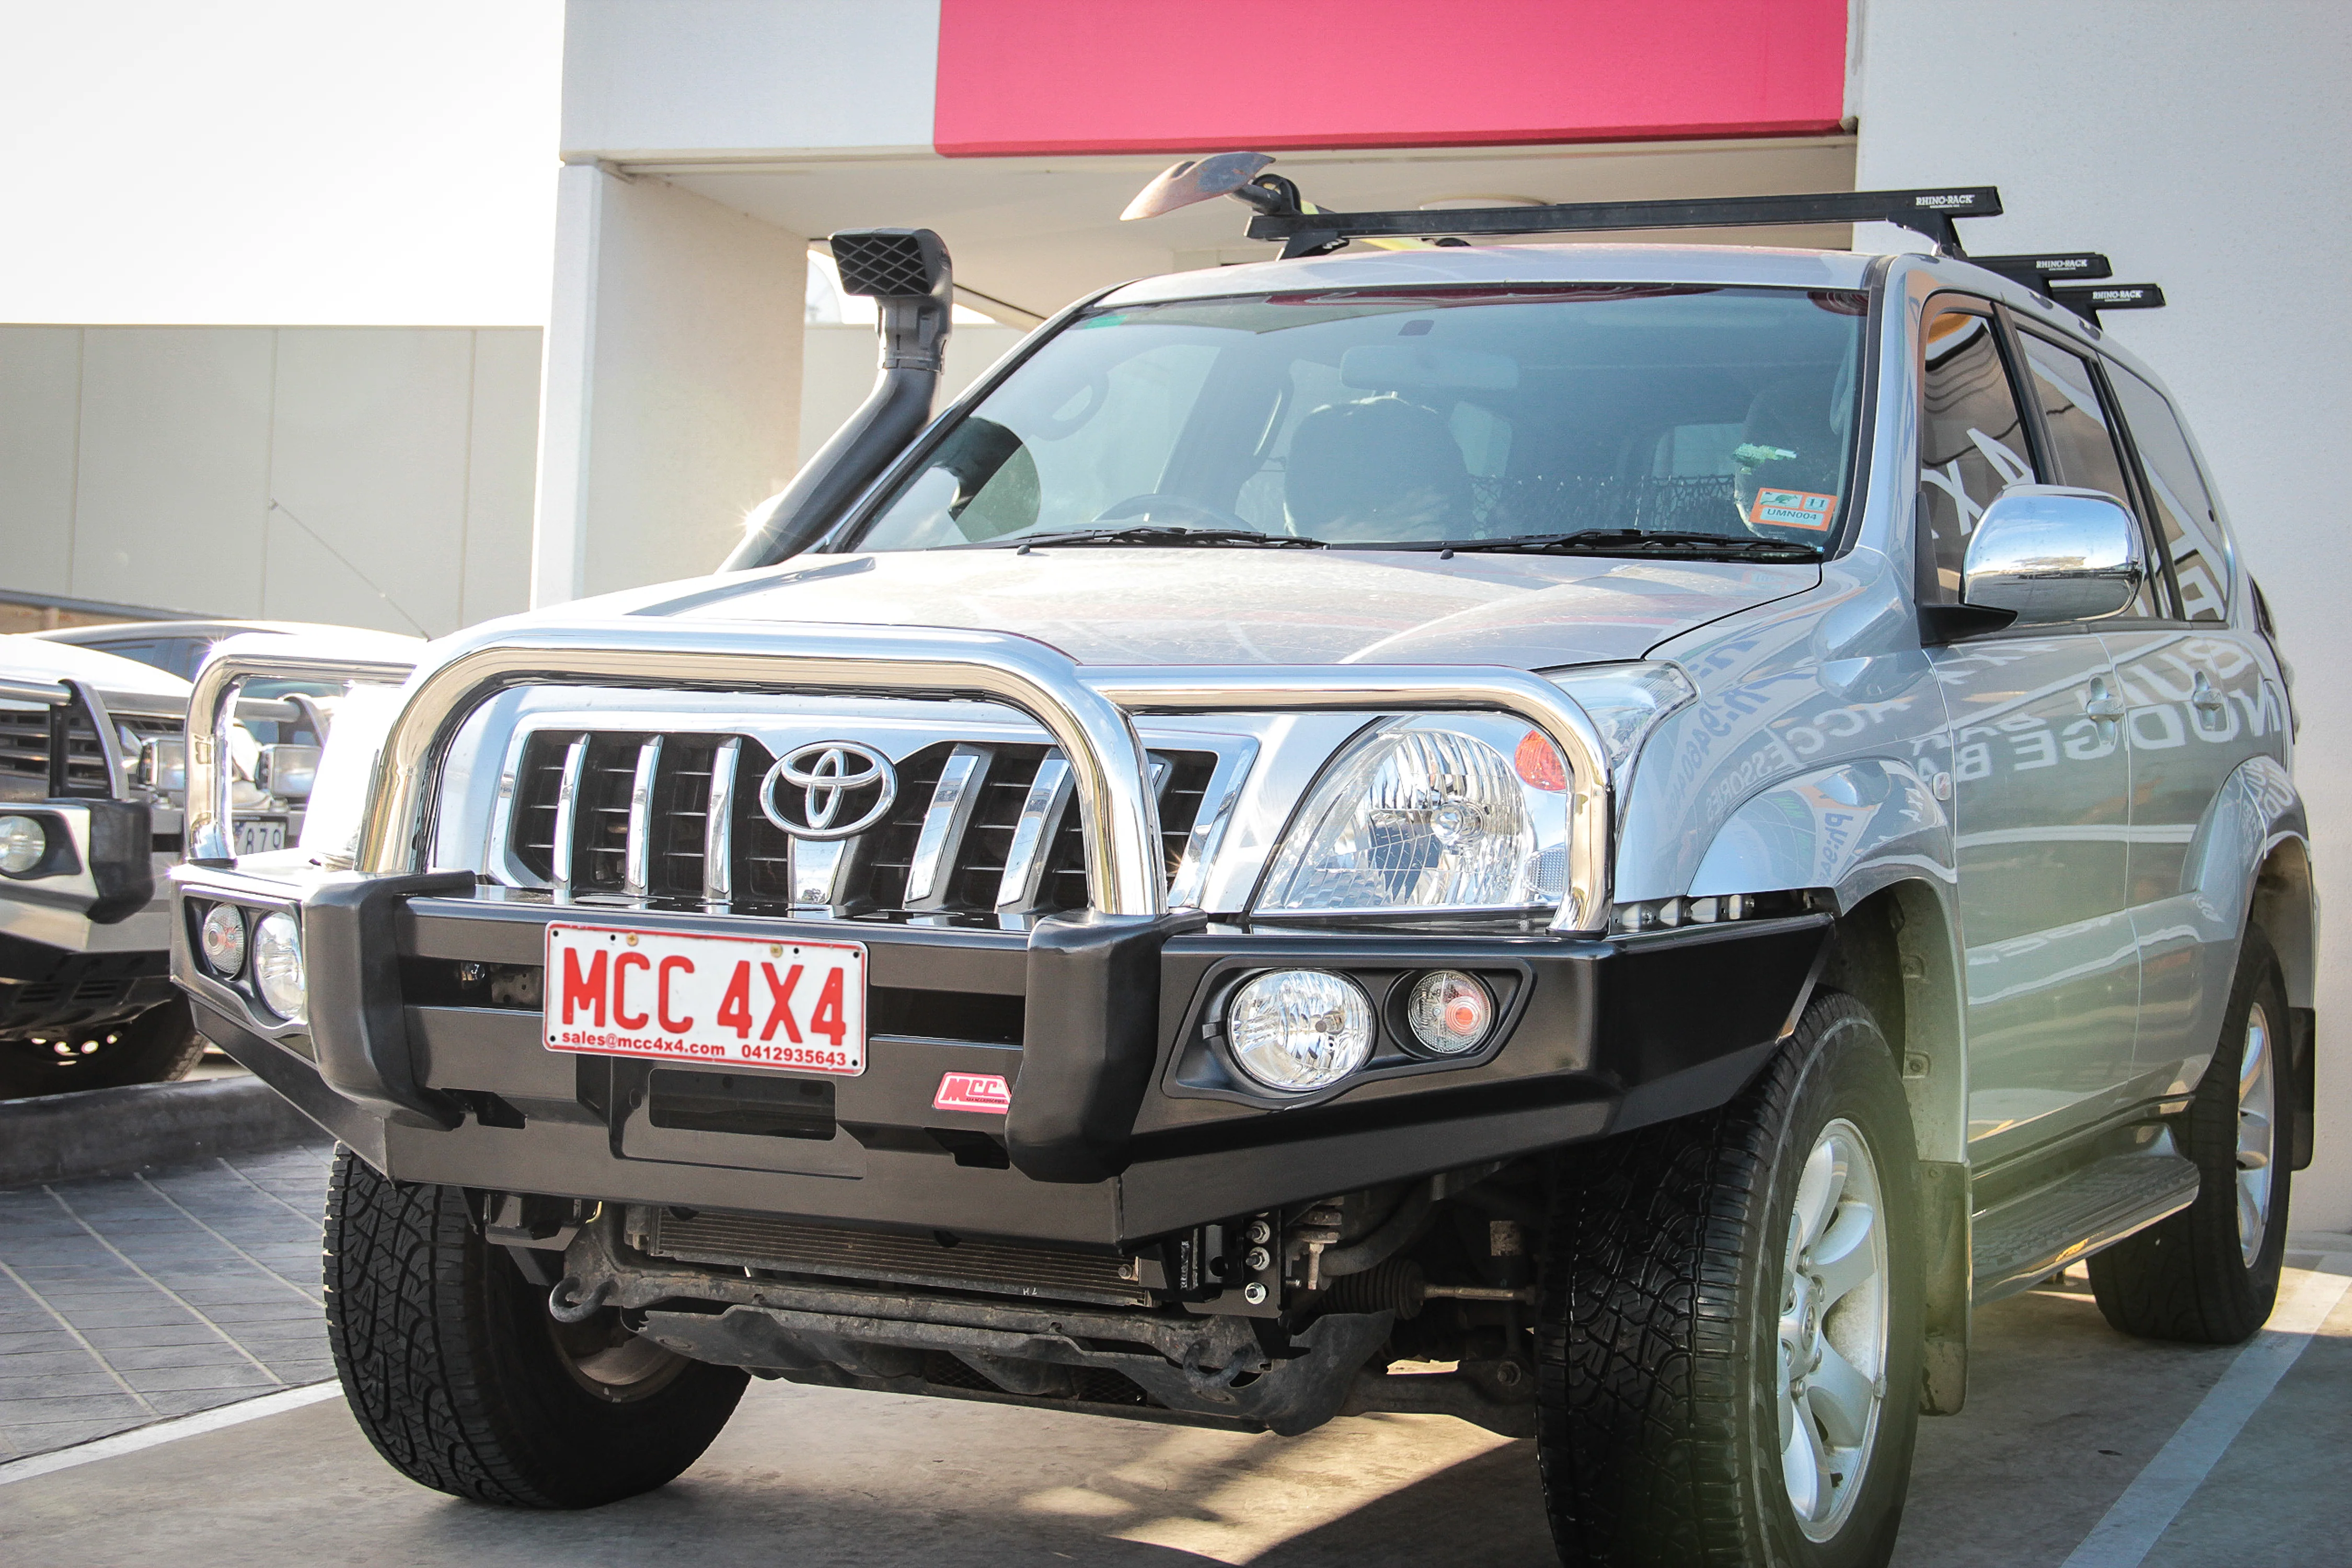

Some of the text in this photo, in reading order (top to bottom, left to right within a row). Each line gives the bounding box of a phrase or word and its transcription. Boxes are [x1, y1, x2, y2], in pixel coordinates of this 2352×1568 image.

[1767, 508, 1817, 521] UMN004
[1808, 498, 1825, 508] 11
[562, 947, 846, 1046] MCC 4X4
[562, 1031, 846, 1066] sales@mcc4x4.com 0412935643
[940, 1078, 1006, 1102] MCC
